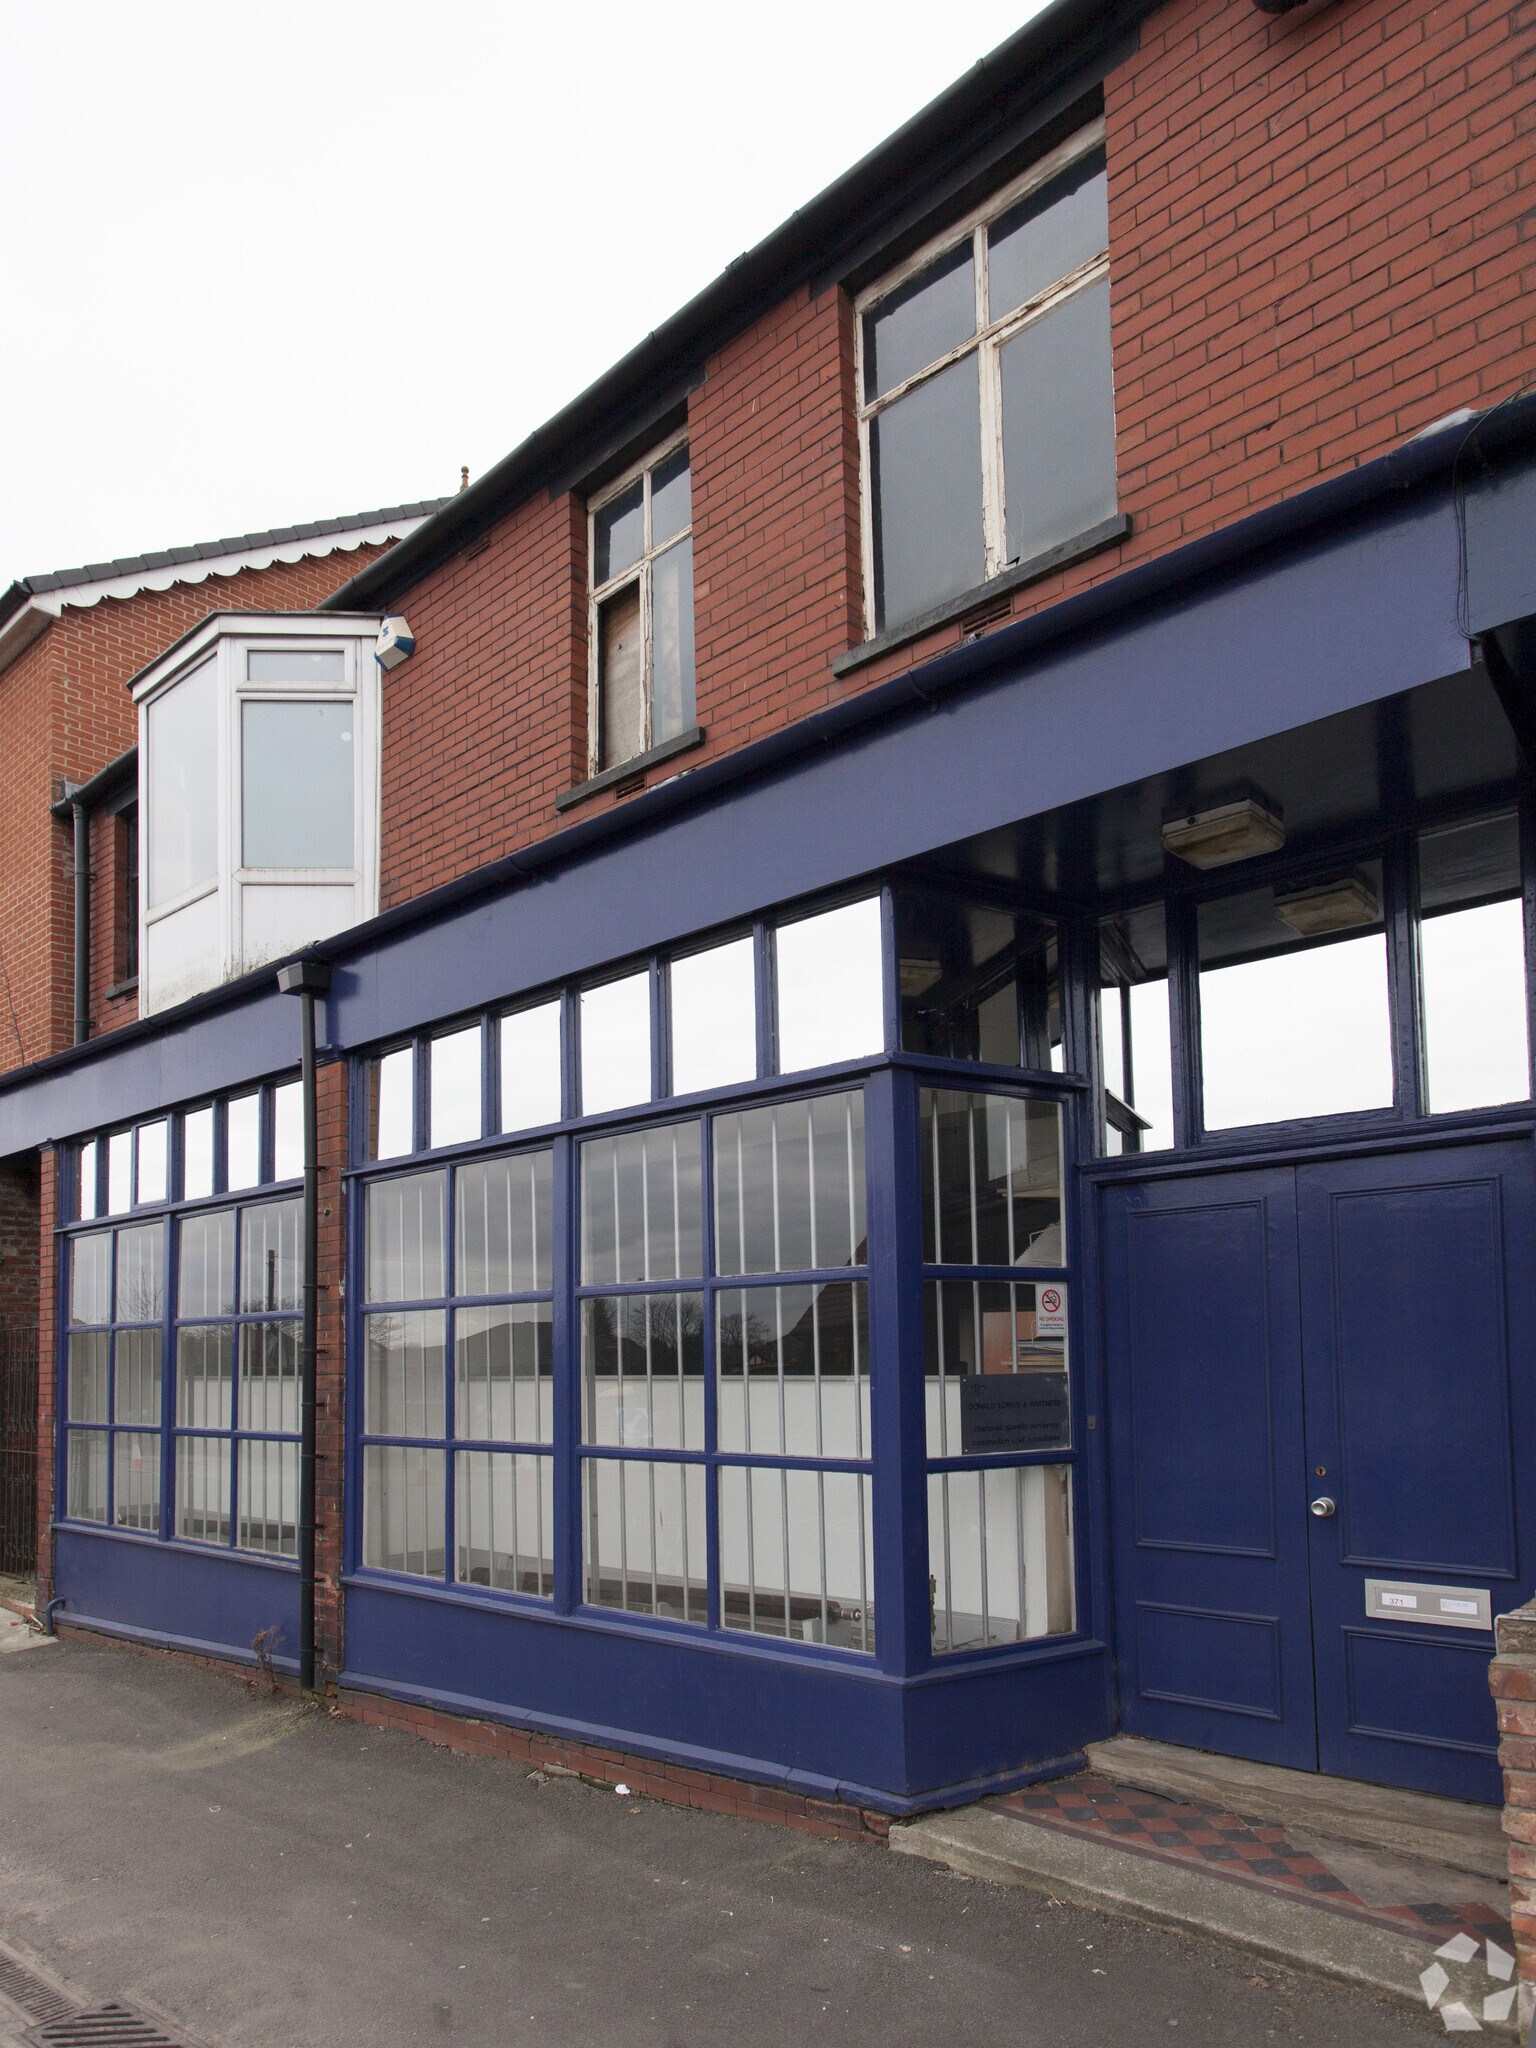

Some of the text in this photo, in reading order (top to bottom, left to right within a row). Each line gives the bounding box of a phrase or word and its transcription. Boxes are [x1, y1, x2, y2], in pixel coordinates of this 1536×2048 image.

[969, 1402, 995, 1410] DONALD
[998, 1401, 1020, 1409] LOMAX
[1030, 1400, 1062, 1408] PARTNERS
[973, 1424, 1002, 1432] chartered
[1004, 1423, 1027, 1432] quantity
[972, 1438, 1009, 1447] construction
